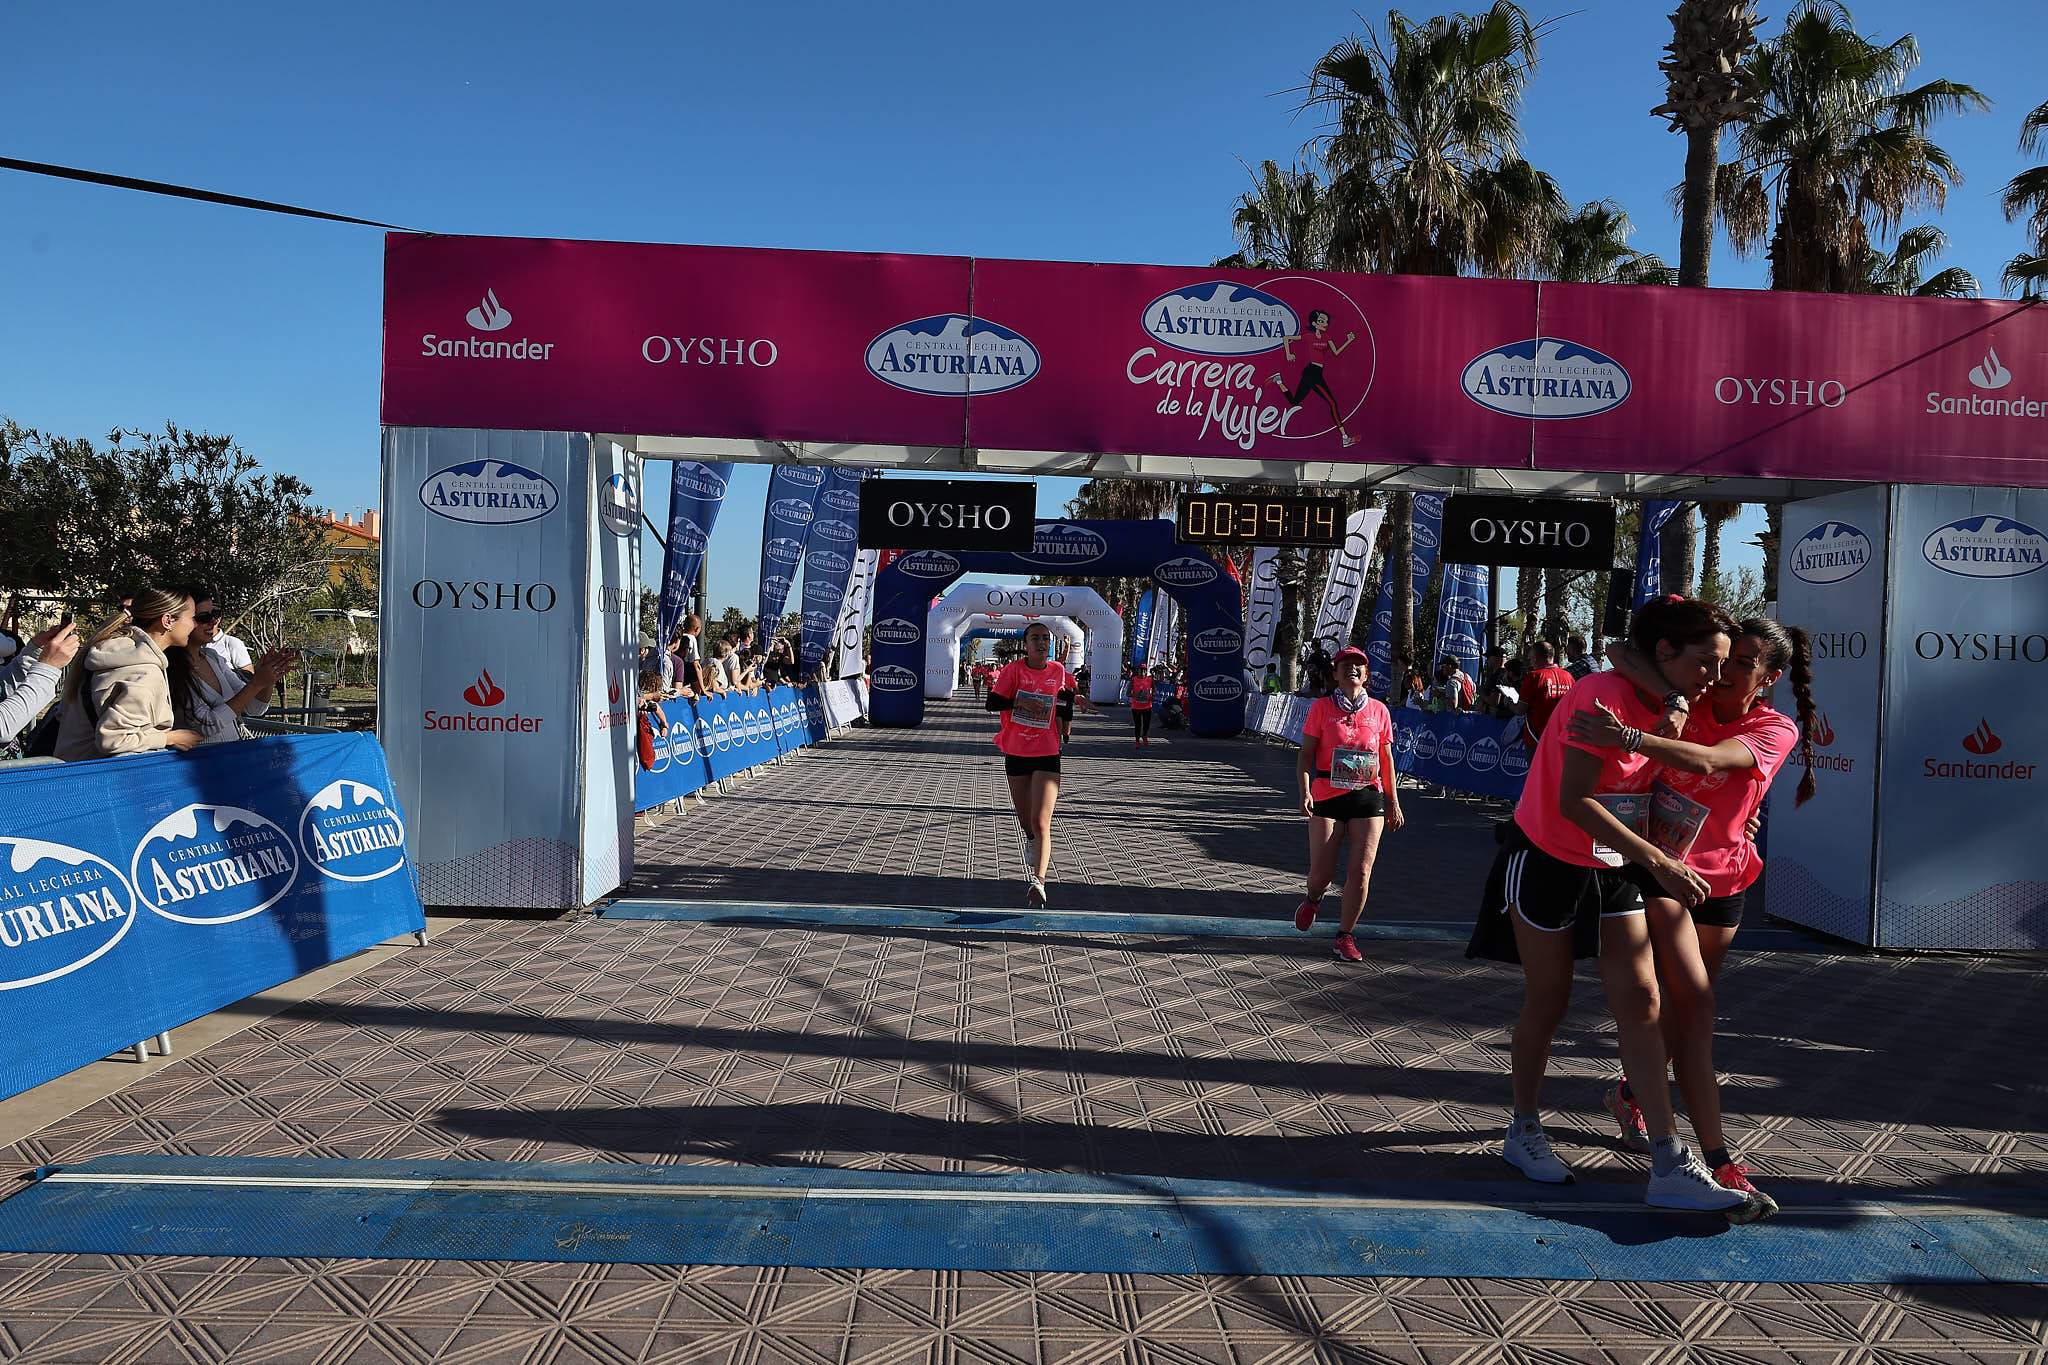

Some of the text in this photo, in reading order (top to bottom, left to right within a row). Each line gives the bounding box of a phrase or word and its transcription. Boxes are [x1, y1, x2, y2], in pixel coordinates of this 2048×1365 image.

[1153, 306, 1287, 339] ASTURIANA
[1178, 304, 1285, 318] CENTRAL LECHERA
[421, 334, 554, 361] Santander
[641, 335, 778, 367] OYSHO
[878, 342, 1028, 376] ASTURIANA
[905, 341, 961, 351] CENTRAL
[1126, 347, 1255, 390] Carrera
[1474, 365, 1618, 399] ASTURIANA
[1501, 364, 1613, 376] CENTRAL LECHERA
[1714, 375, 1847, 408] OYSHO
[1926, 391, 2048, 418] Santander
[1156, 387, 1302, 450] de la Mujer
[429, 481, 549, 510] ASTURIANA
[451, 480, 545, 491] CENTRAL LECHERA
[887, 501, 1011, 531] OYSHO
[1189, 502, 1333, 538] 00:39:14
[1470, 518, 1591, 548] OYSHO
[1952, 536, 2041, 546] CENTRAL LECHERA
[1032, 541, 1099, 556] STURIANA
[1794, 547, 1865, 571] ASTURIANA
[1932, 537, 2043, 564] ASTURIANA
[903, 559, 955, 573] ASTURIANA
[1159, 567, 1214, 580] ASTURIANA
[412, 579, 557, 613] OYSHO
[598, 584, 635, 616] OYSHO
[986, 590, 1065, 608] OYSHO
[1247, 559, 1279, 669] OYSHO
[876, 627, 917, 639] ASTURIANA
[1197, 637, 1240, 648] ASTURIANA
[1809, 631, 1867, 659] YSHO
[1915, 631, 2048, 663] OYSHO
[873, 673, 914, 686] ASTURIANA
[1197, 684, 1240, 695] ASTURIANA
[424, 710, 544, 733] Santander
[1789, 750, 1855, 773] Satander
[1924, 757, 2037, 780] Santander
[323, 814, 362, 828] CENTRAL
[168, 830, 276, 863] CENTRAL LECHERA
[29, 868, 103, 894] LECHERA
[151, 845, 292, 906] ASTURIANA
